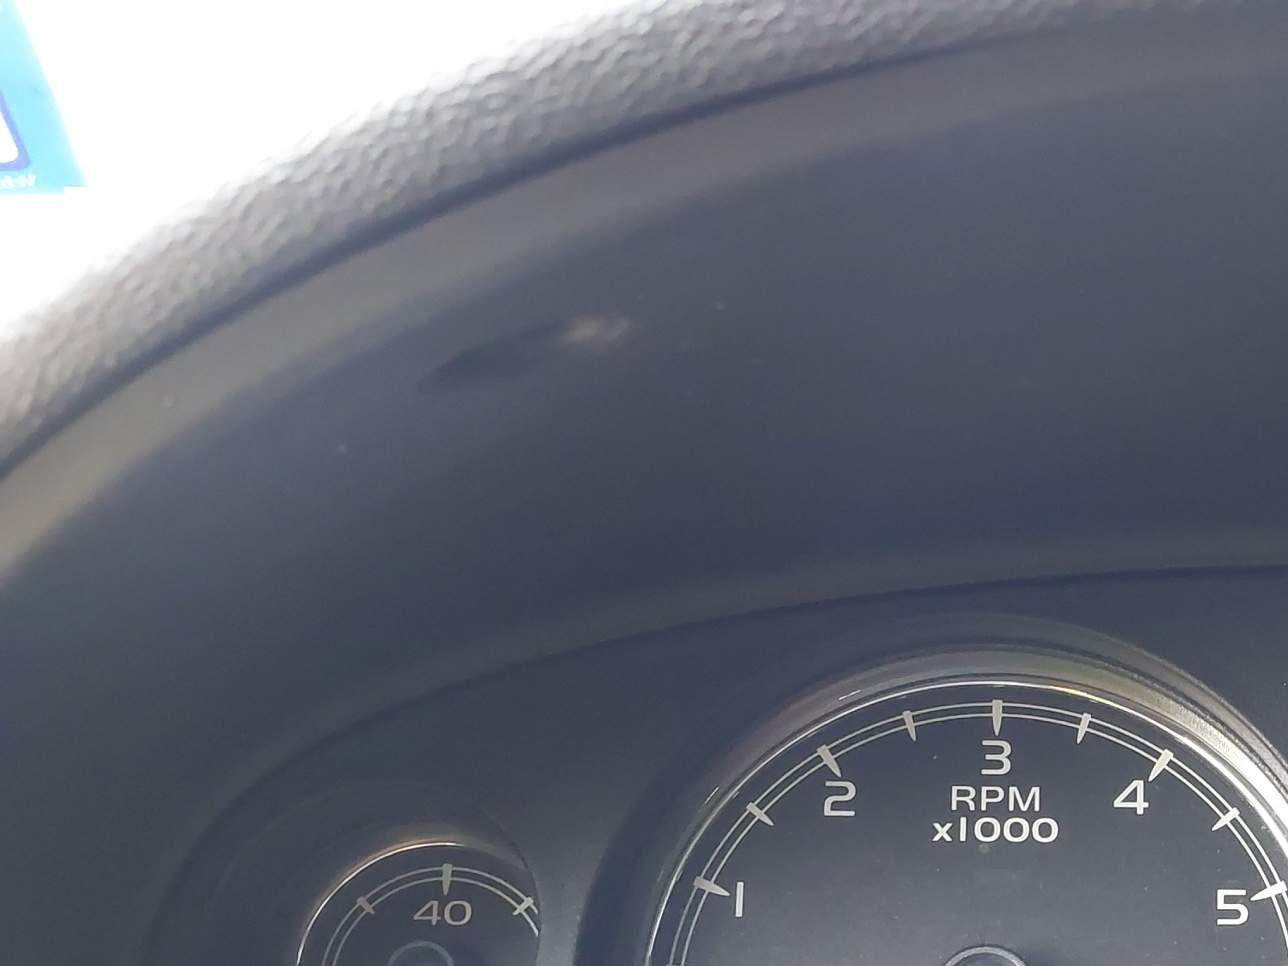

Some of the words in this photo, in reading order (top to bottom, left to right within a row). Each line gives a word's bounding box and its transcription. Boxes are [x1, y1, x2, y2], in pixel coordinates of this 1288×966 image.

[981, 740, 1012, 775] 3
[823, 780, 856, 817] 2
[951, 785, 1040, 812] RPM
[1113, 779, 1149, 816] 4
[932, 816, 1059, 843] x1000
[413, 900, 472, 926] 40
[735, 881, 745, 918] 1
[1216, 889, 1250, 926] 5
